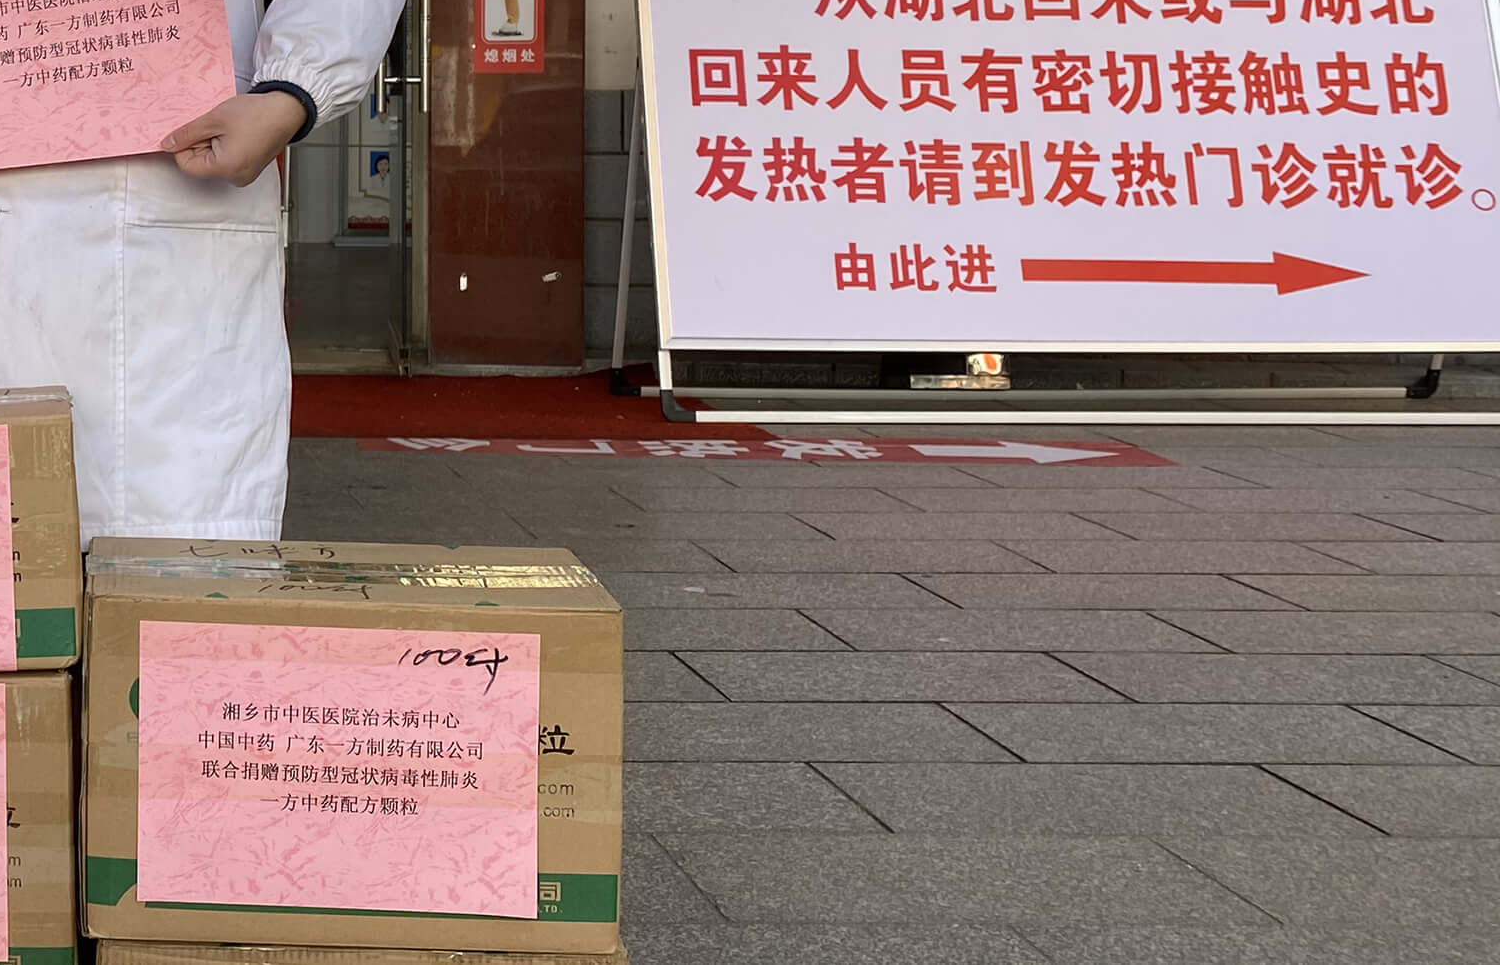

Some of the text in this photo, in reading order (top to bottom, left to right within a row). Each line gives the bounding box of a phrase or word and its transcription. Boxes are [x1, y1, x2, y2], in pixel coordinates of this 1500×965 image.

[17, 0, 182, 40] 广东一方制药有限公司
[3, 57, 135, 88] 一方中药配方颗粒
[687, 43, 1451, 119] 回来人员有密切接触史的
[694, 135, 1498, 212] 发热者请到发热门诊就诊。
[833, 242, 999, 296] 由此进
[221, 701, 461, 730] 湘乡市中医医院治未病中心
[197, 730, 485, 762] 中国中药 广东一方制药有限公司
[201, 760, 479, 790] 联合捐赠预防型冠状病毒性肺炎
[259, 795, 419, 817] 一方中药配方颗粒
